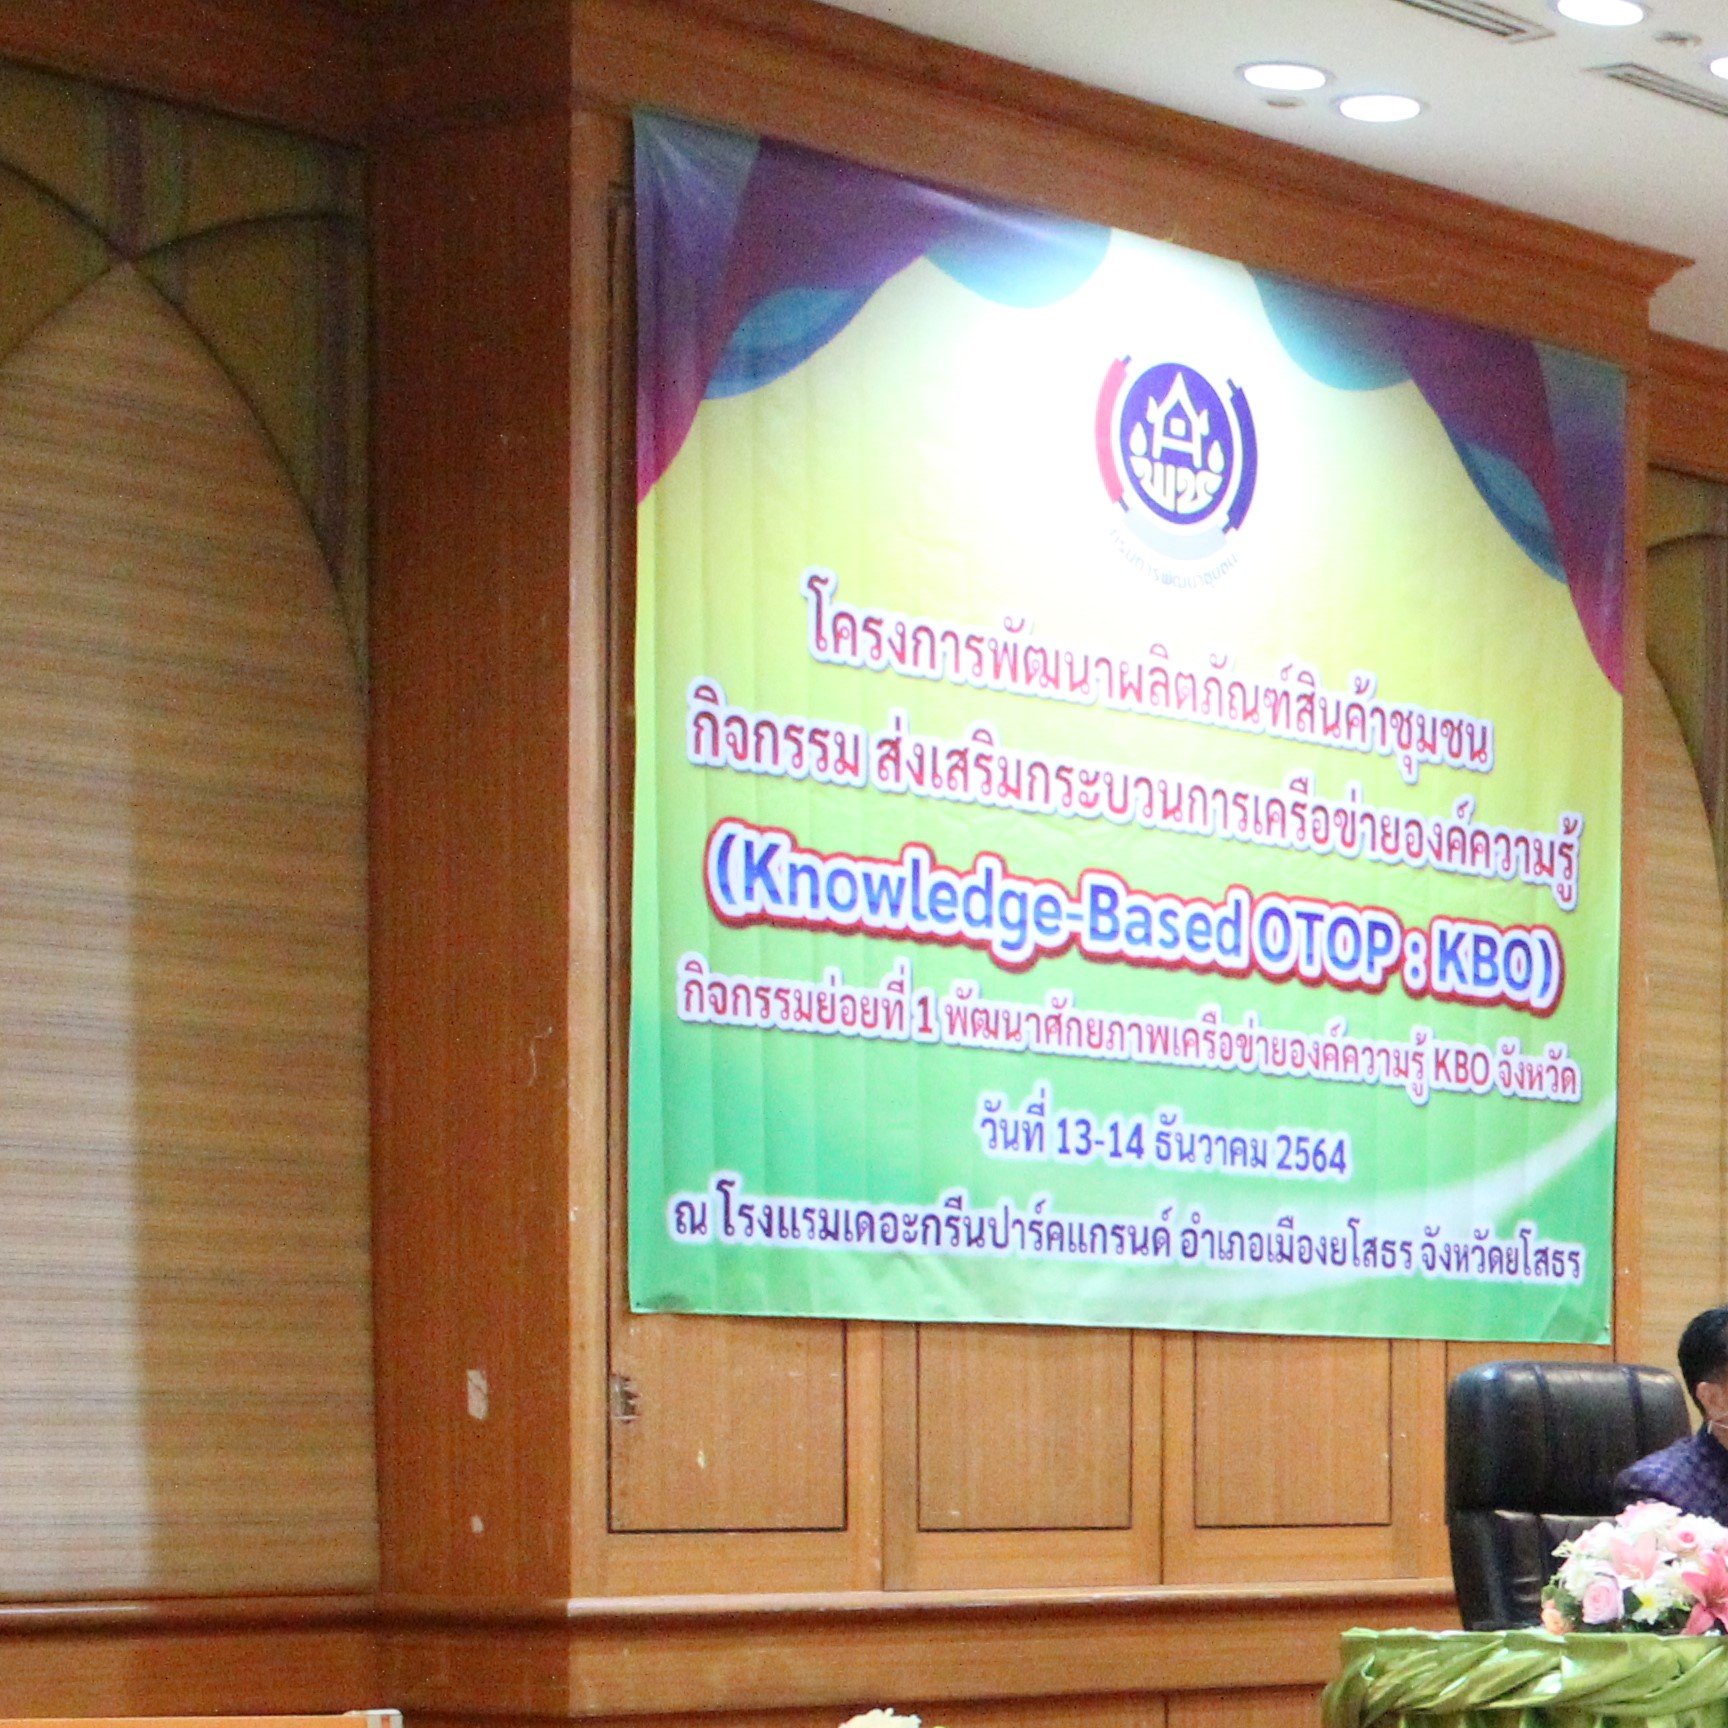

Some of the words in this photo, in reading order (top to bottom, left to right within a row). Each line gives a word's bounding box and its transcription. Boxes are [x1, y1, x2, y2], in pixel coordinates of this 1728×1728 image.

[807, 574, 1488, 775] โครงการพัฒนาผลิตภัณฑ์สินค้าชุมชน
[693, 684, 860, 778] กิจกรรม
[876, 715, 1579, 903] ส่งเสริมกระบวนการเครือข่ายองค์ความรู้
[717, 832, 1242, 958] (Knowledge-Based
[1258, 906, 1394, 975] OTOP
[1438, 928, 1552, 999] KBO)
[683, 959, 905, 1032] กิจกรรมย่อยที่
[917, 995, 933, 1034] 1
[944, 985, 1426, 1097] พัฒนาศักยภาพเครือข่ายองค์ความรู้
[1433, 1047, 1490, 1087] KBO
[1497, 1043, 1577, 1096] จังหวัด
[980, 1087, 1046, 1153] วันที่
[1056, 1117, 1145, 1160] 13-14
[1154, 1112, 1268, 1169] ธันวาคม
[1275, 1134, 1347, 1175] 2564
[674, 1199, 708, 1236] ณ
[715, 1178, 1173, 1258] โรงแรมเดอะกรีนปาร์คแกรนด์
[1180, 1211, 1413, 1269] อำเภอเมืองยโสธร
[1420, 1225, 1581, 1280] จังหวัดยโสธร
